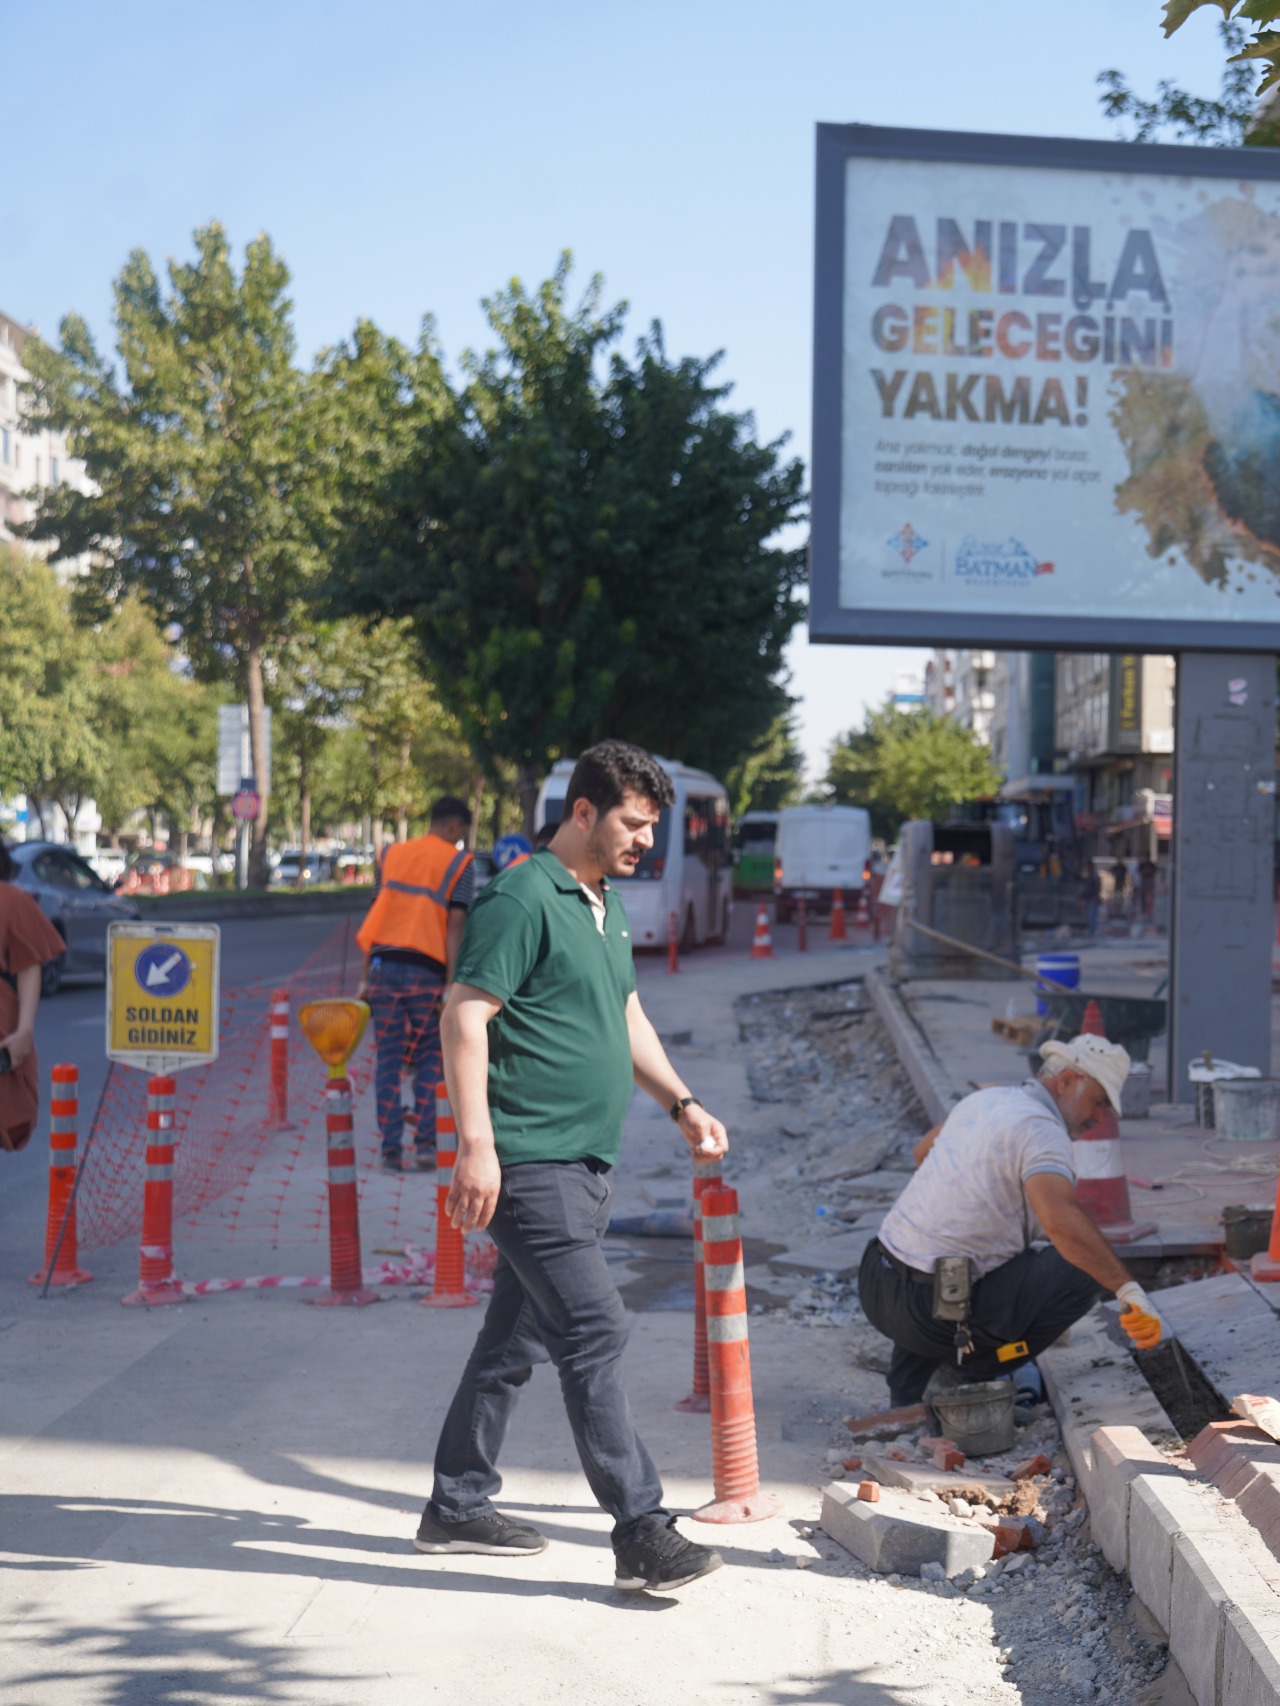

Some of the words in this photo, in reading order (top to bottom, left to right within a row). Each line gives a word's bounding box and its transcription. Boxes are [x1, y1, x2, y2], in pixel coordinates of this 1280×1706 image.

[871, 214, 1170, 303] ANIZLA
[871, 301, 1174, 368] GELECEĞİNİ
[870, 369, 1089, 428] YAKMA!
[126, 1006, 199, 1024] SOLDAN
[128, 1025, 196, 1046] GİDİNİZ
